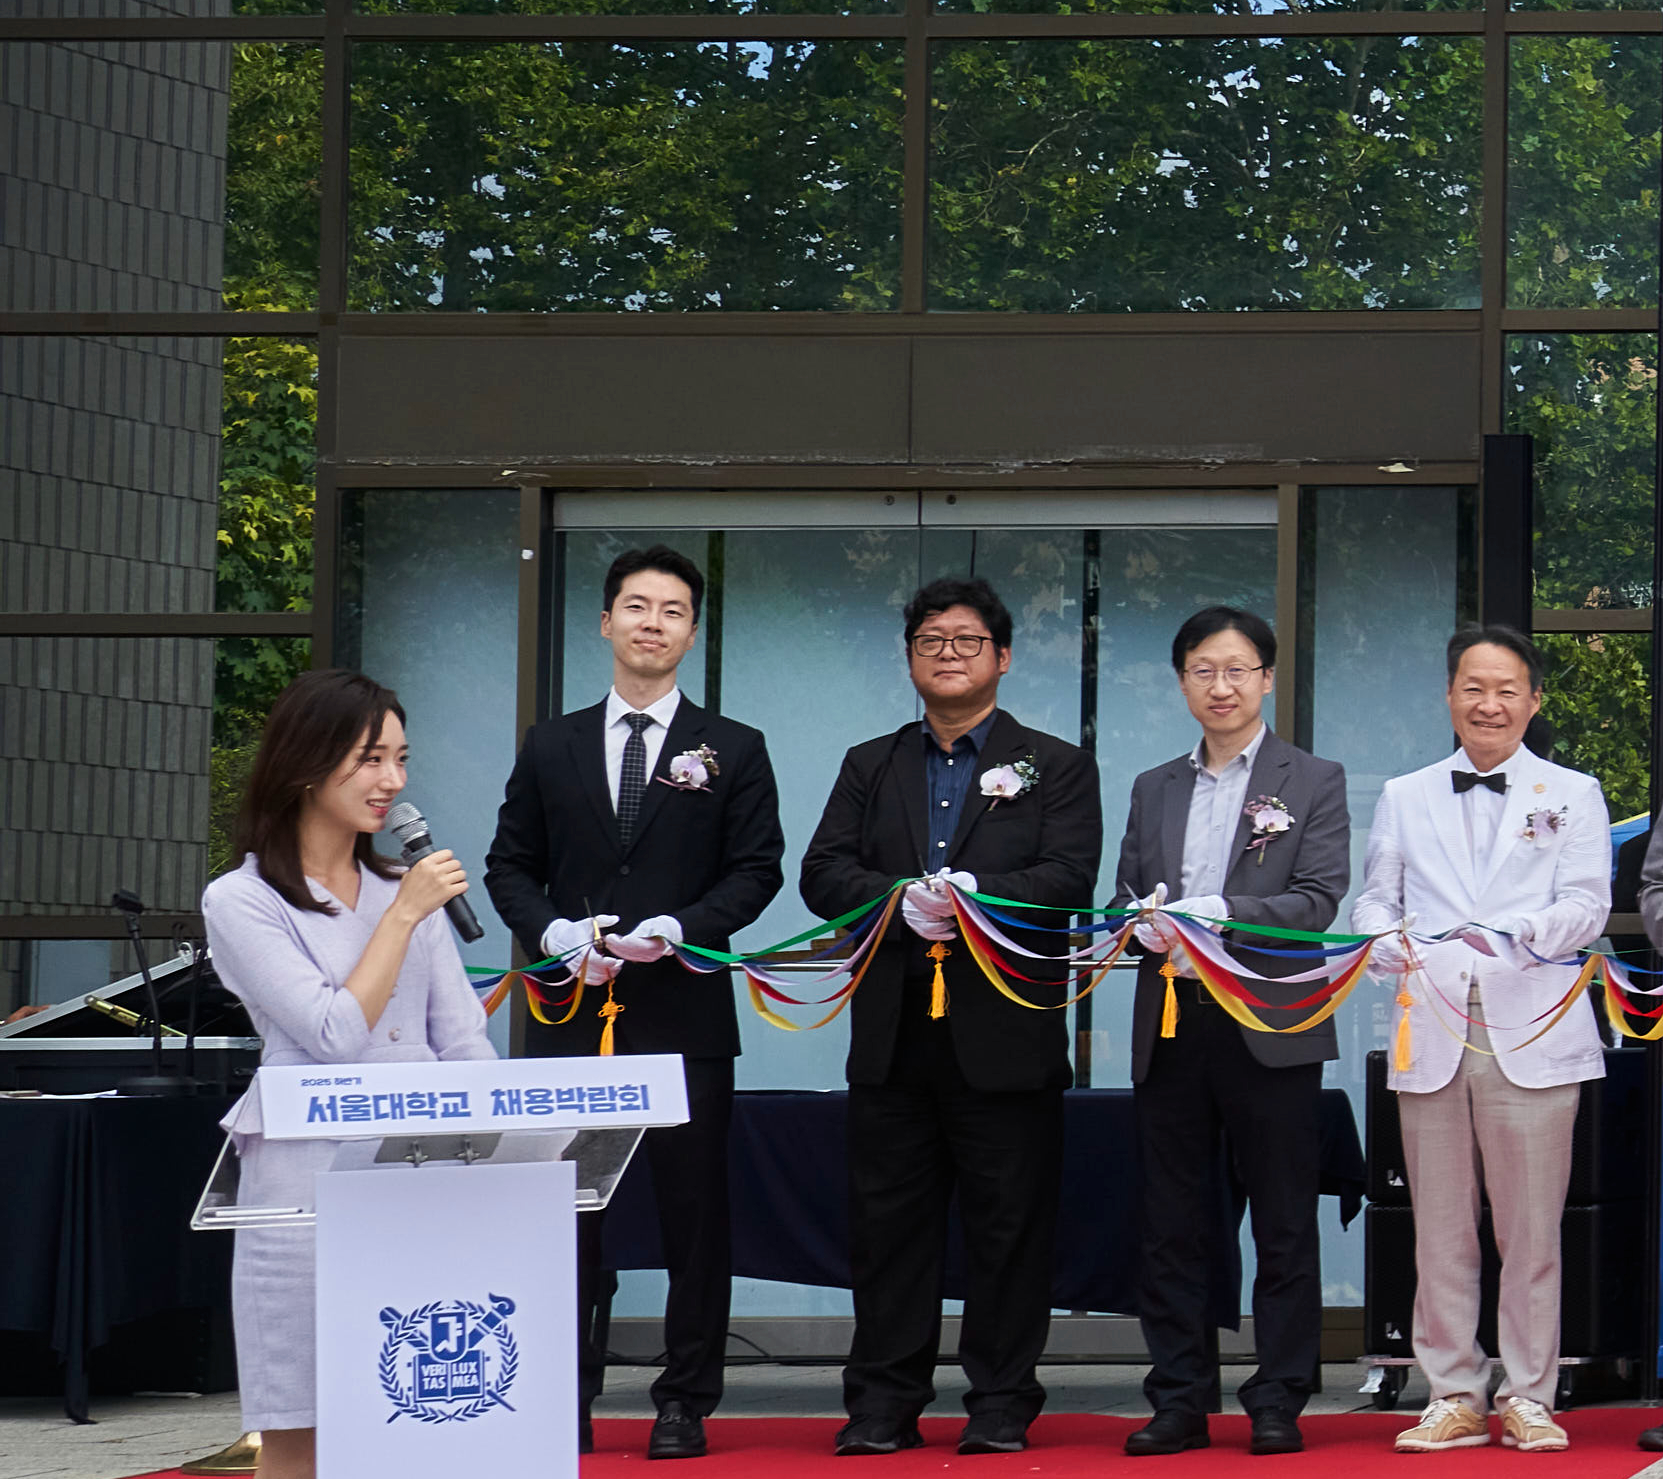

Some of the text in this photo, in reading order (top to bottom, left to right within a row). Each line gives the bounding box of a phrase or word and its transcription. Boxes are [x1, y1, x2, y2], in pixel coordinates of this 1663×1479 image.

[306, 1083, 650, 1123] 서울대학교 채용박람회
[421, 1361, 478, 1377] VERI LUX
[422, 1376, 446, 1390] TAS
